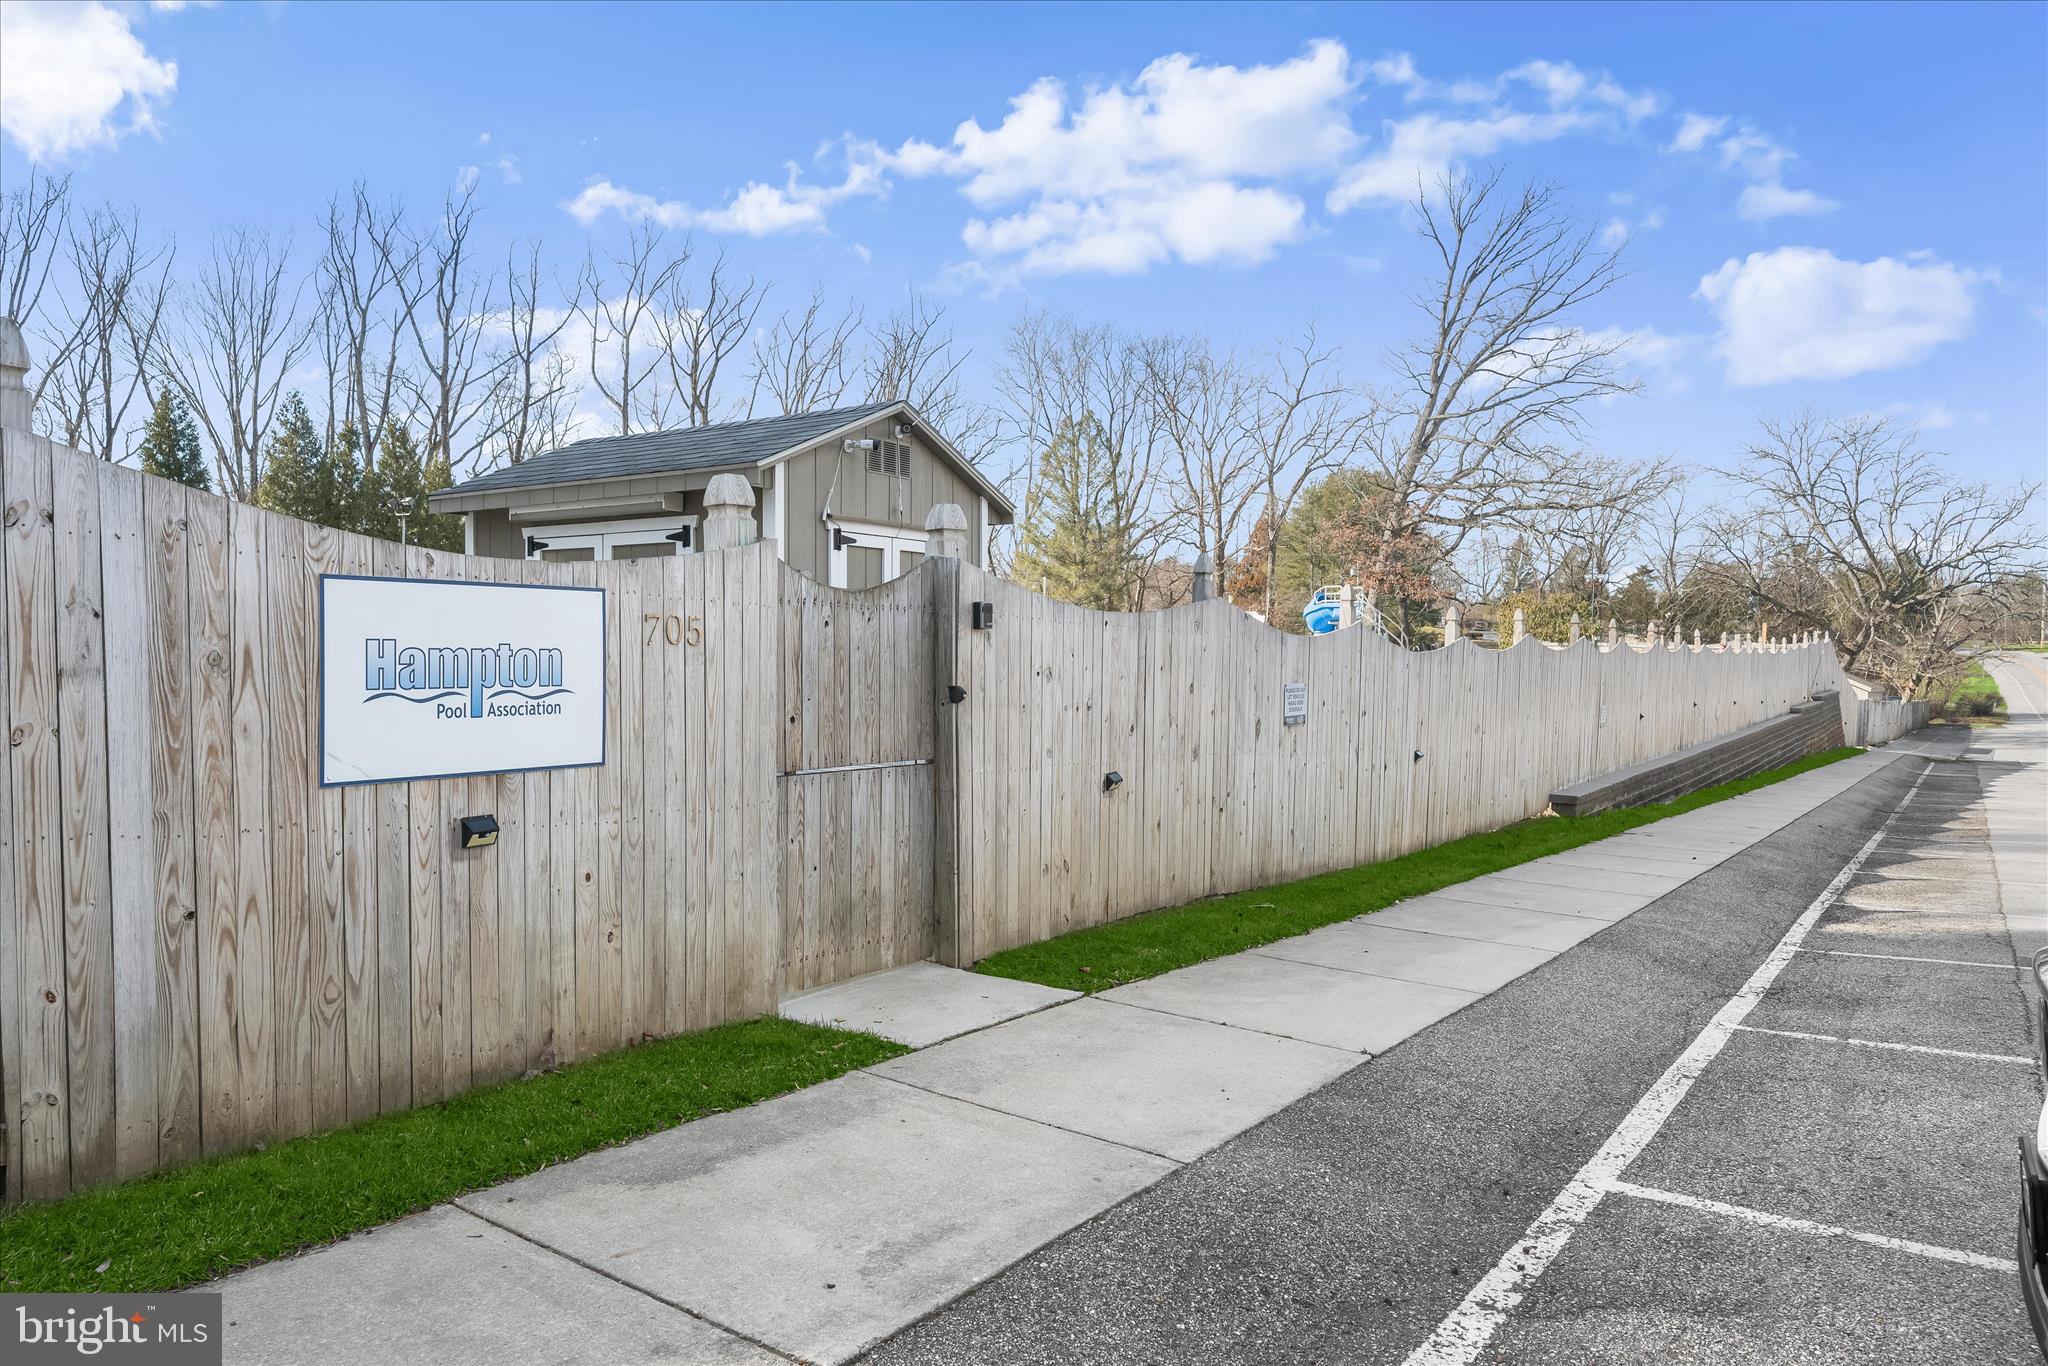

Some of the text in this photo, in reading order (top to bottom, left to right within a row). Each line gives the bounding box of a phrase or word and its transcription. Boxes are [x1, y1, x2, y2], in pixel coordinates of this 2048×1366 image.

[644, 612, 705, 647] 705
[365, 638, 563, 719] Hampton
[436, 700, 562, 720] Pool Association
